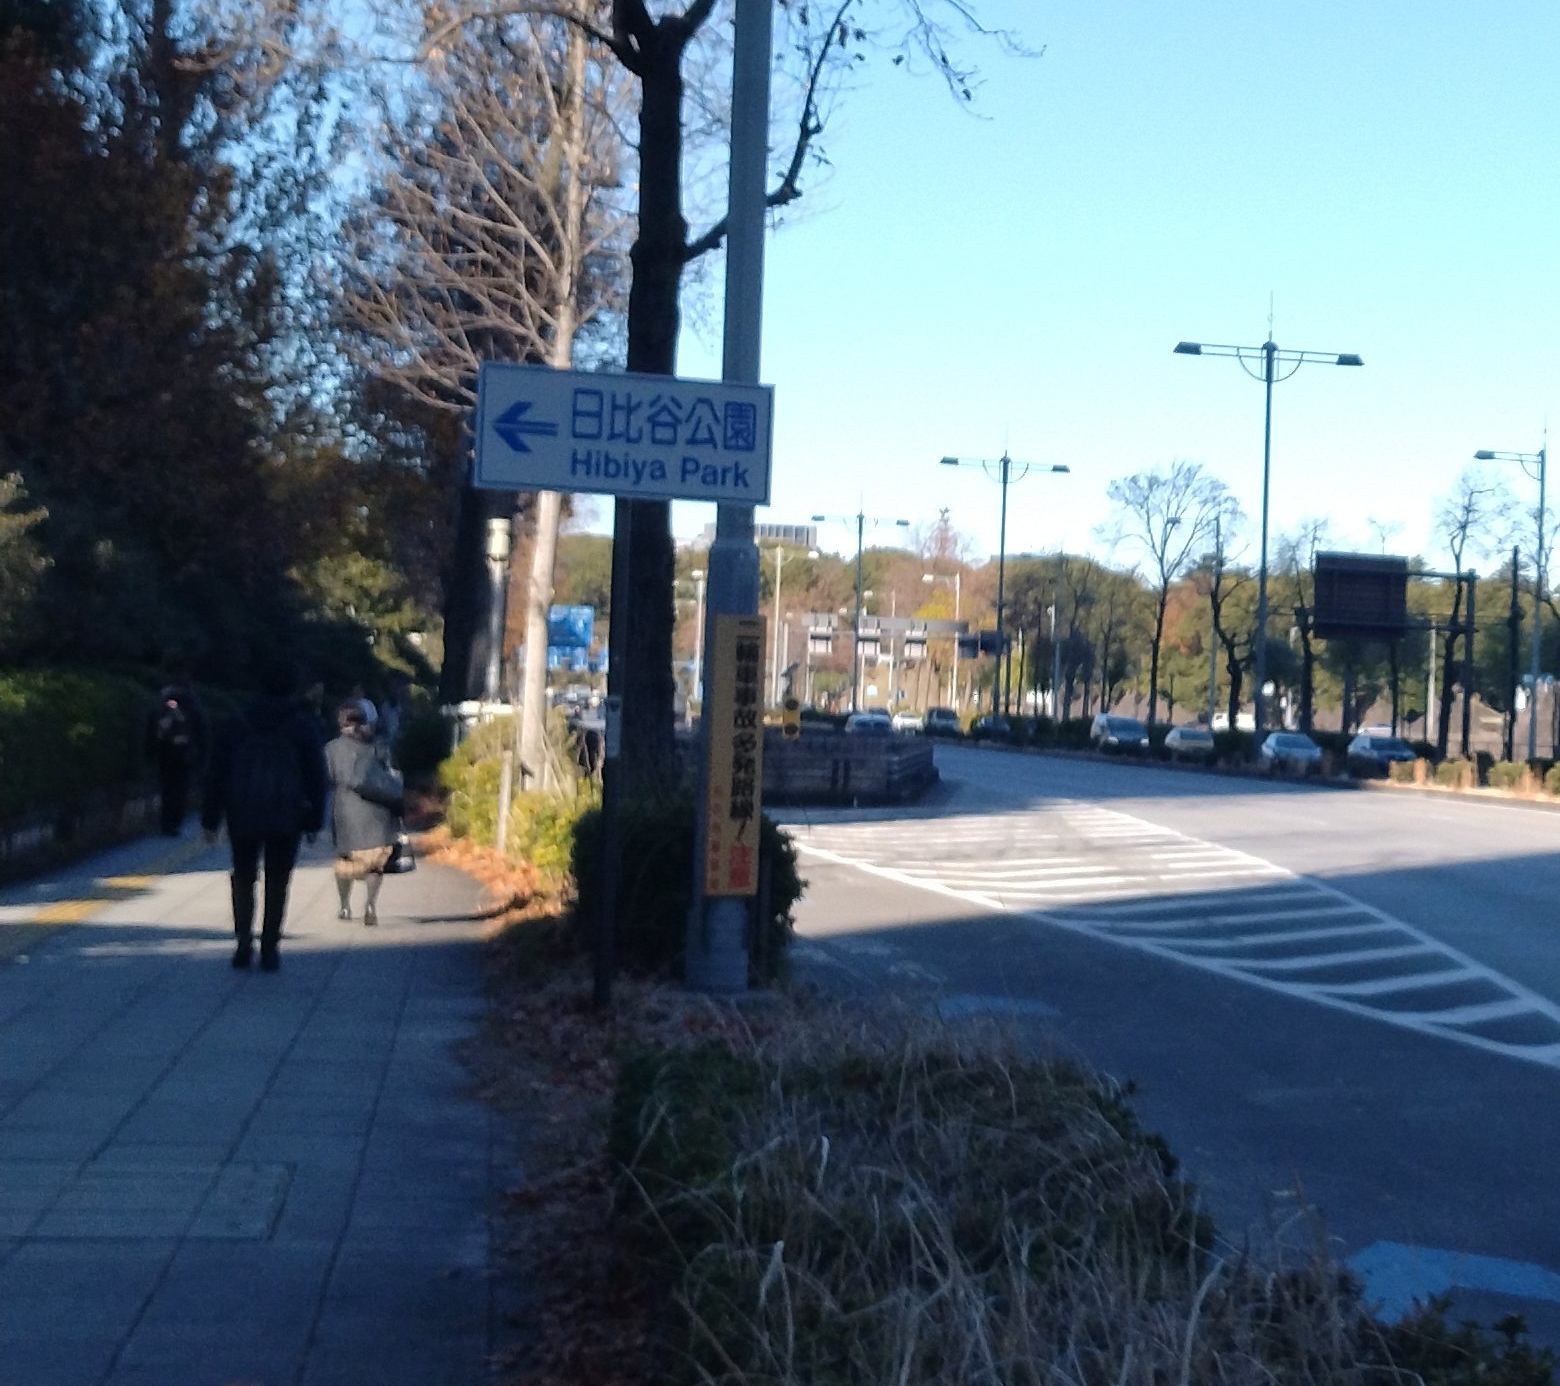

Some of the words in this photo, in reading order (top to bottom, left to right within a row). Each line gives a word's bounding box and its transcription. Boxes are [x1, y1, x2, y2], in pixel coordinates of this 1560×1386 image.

[572, 387, 756, 451] 日比谷公園
[571, 449, 668, 485] Hibiya
[680, 456, 750, 489] Park
